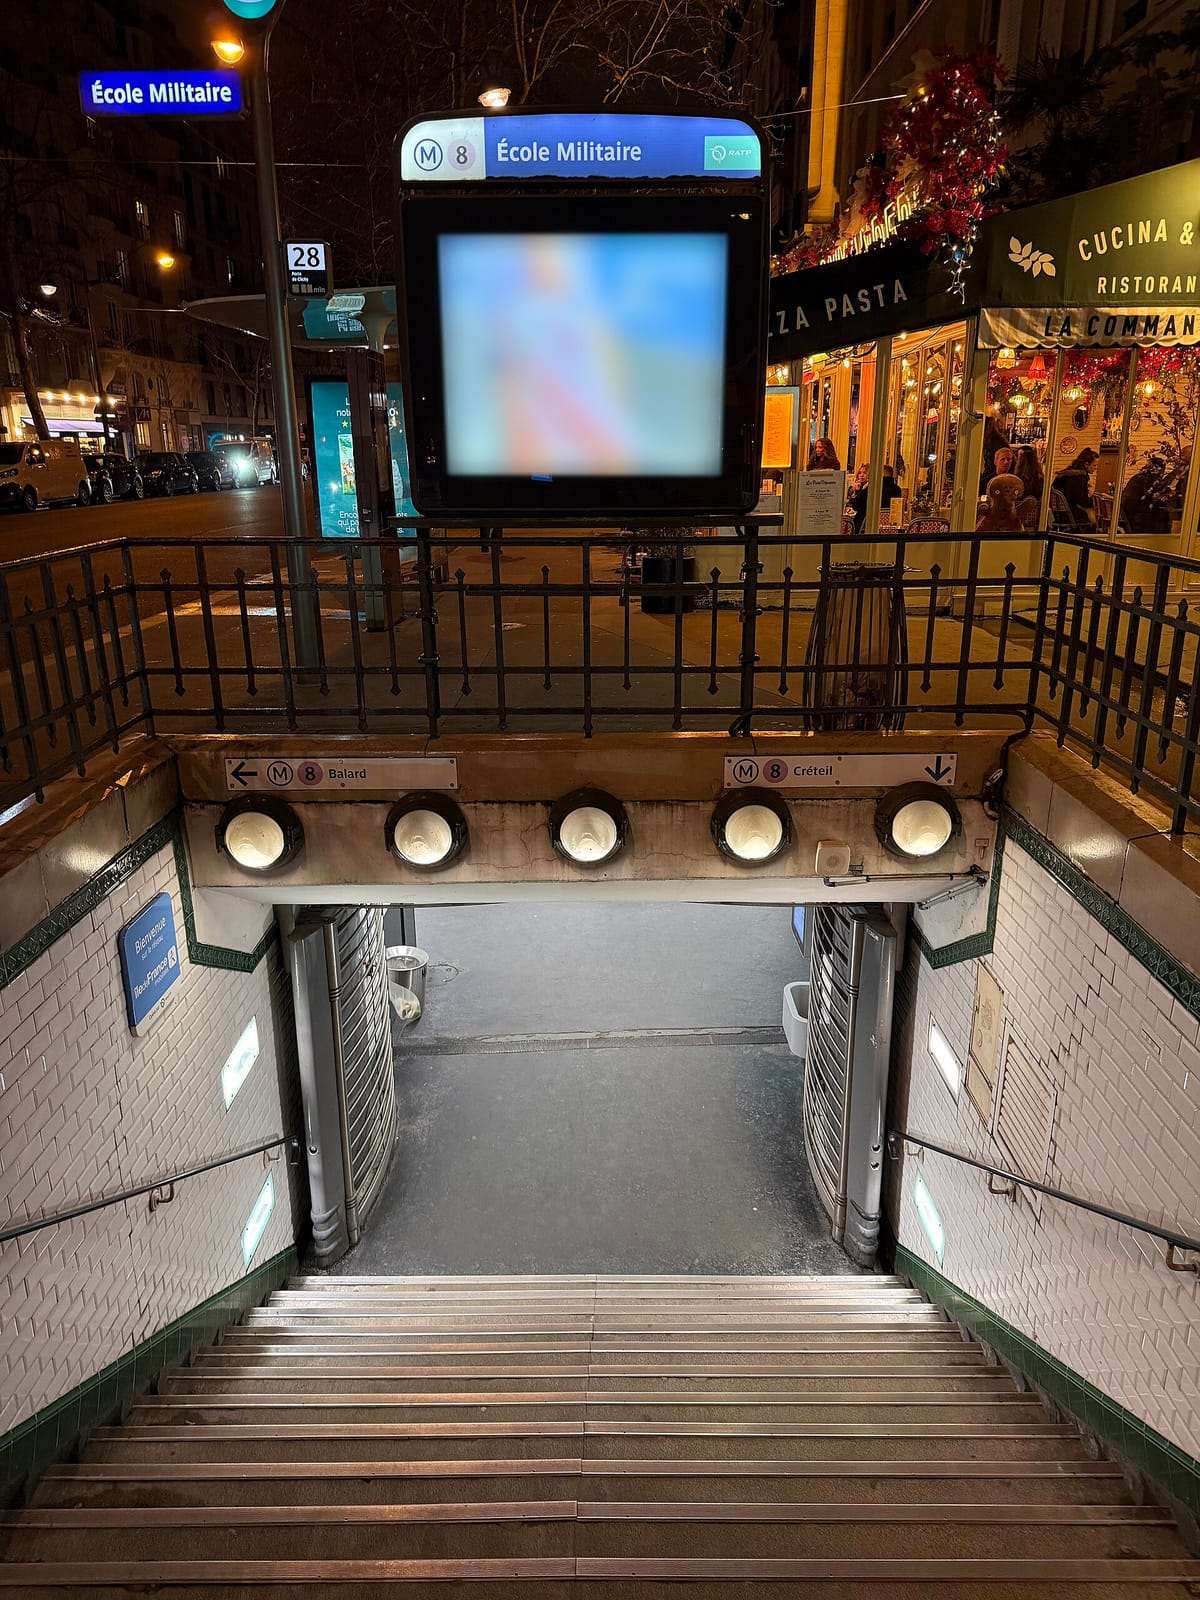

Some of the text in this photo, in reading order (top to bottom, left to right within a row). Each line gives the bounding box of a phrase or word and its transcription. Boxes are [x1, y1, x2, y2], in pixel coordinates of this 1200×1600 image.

[91, 79, 232, 104] École Militaire
[456, 145, 468, 164] 8
[497, 139, 642, 162] École Militaire
[1078, 219, 1194, 261] CUCINA &
[292, 247, 320, 267] 28
[313, 286, 326, 294] min
[1097, 275, 1197, 294] RISTORAN
[768, 279, 908, 337] ZA PASTA
[1044, 314, 1196, 337] LA COMMAN
[305, 767, 316, 781] 8
[328, 769, 367, 779] Balard
[770, 764, 781, 778] 8
[793, 765, 833, 776] Créteil
[134, 916, 167, 954] Bienvenue
